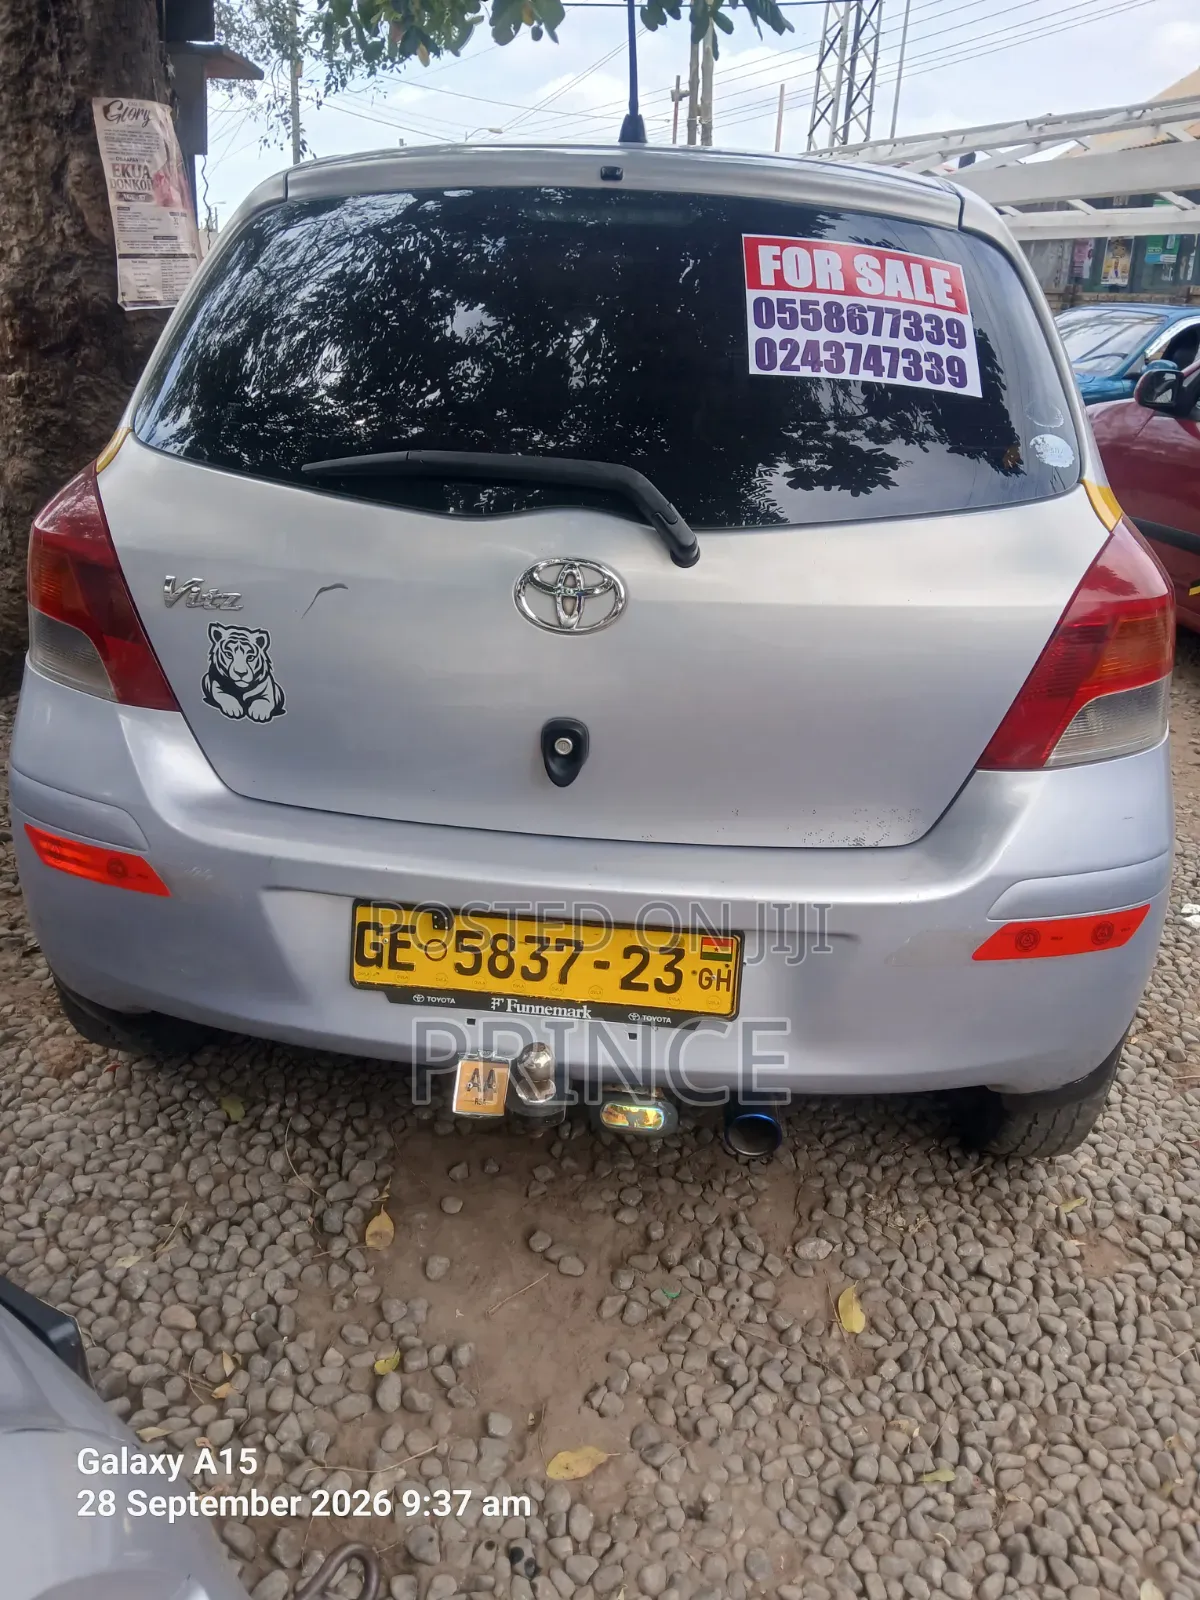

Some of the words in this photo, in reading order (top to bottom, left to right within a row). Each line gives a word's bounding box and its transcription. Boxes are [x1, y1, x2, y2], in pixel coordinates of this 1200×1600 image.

[103, 100, 151, 128] Glory
[111, 163, 152, 179] EKUA
[757, 244, 845, 291] FOR
[853, 254, 956, 308] SALE
[752, 296, 967, 350] 0558677339
[754, 336, 968, 389] 0243747339
[163, 574, 243, 611] Vitz
[355, 920, 416, 972] GE
[698, 967, 732, 992] GH
[426, 995, 456, 1004] TOYOTA
[505, 998, 592, 1019] Funnemark
[641, 1014, 672, 1024] TOYOTA
